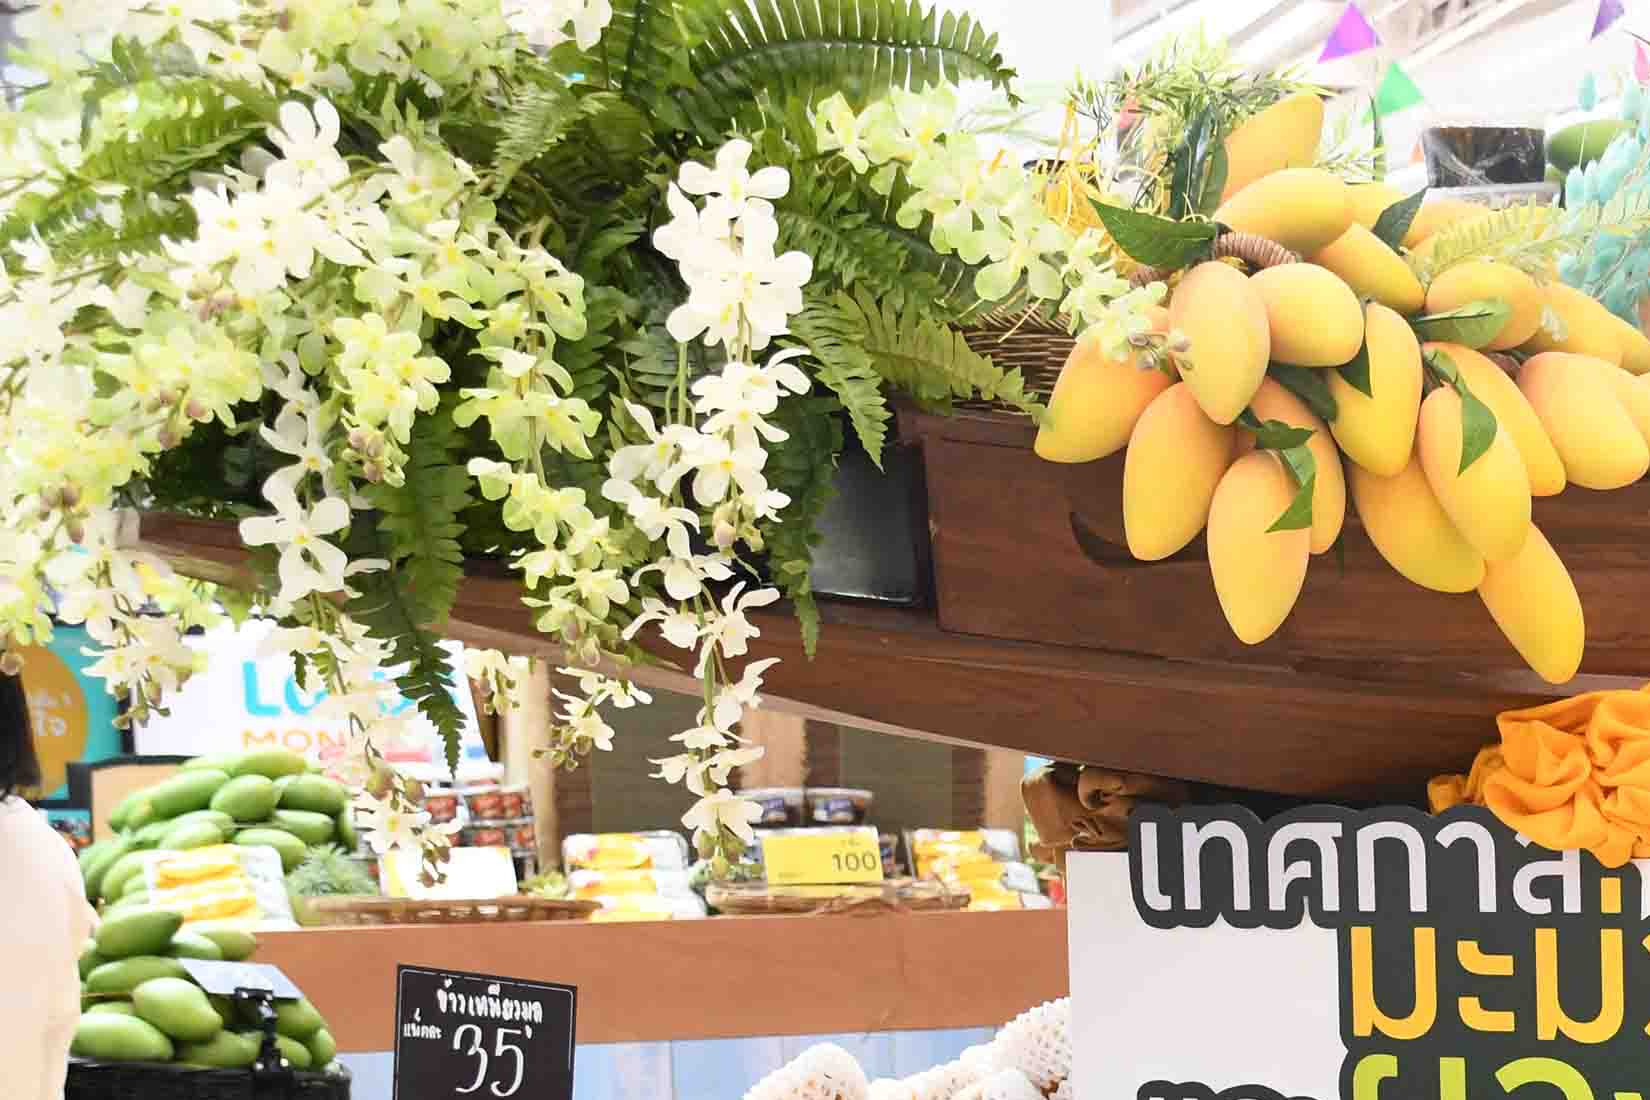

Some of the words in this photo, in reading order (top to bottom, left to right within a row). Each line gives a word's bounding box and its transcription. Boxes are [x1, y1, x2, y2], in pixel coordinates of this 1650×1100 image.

[832, 852, 877, 871] 100
[1140, 821, 1582, 914] เทศกาล
[453, 1023, 524, 1097] 35
